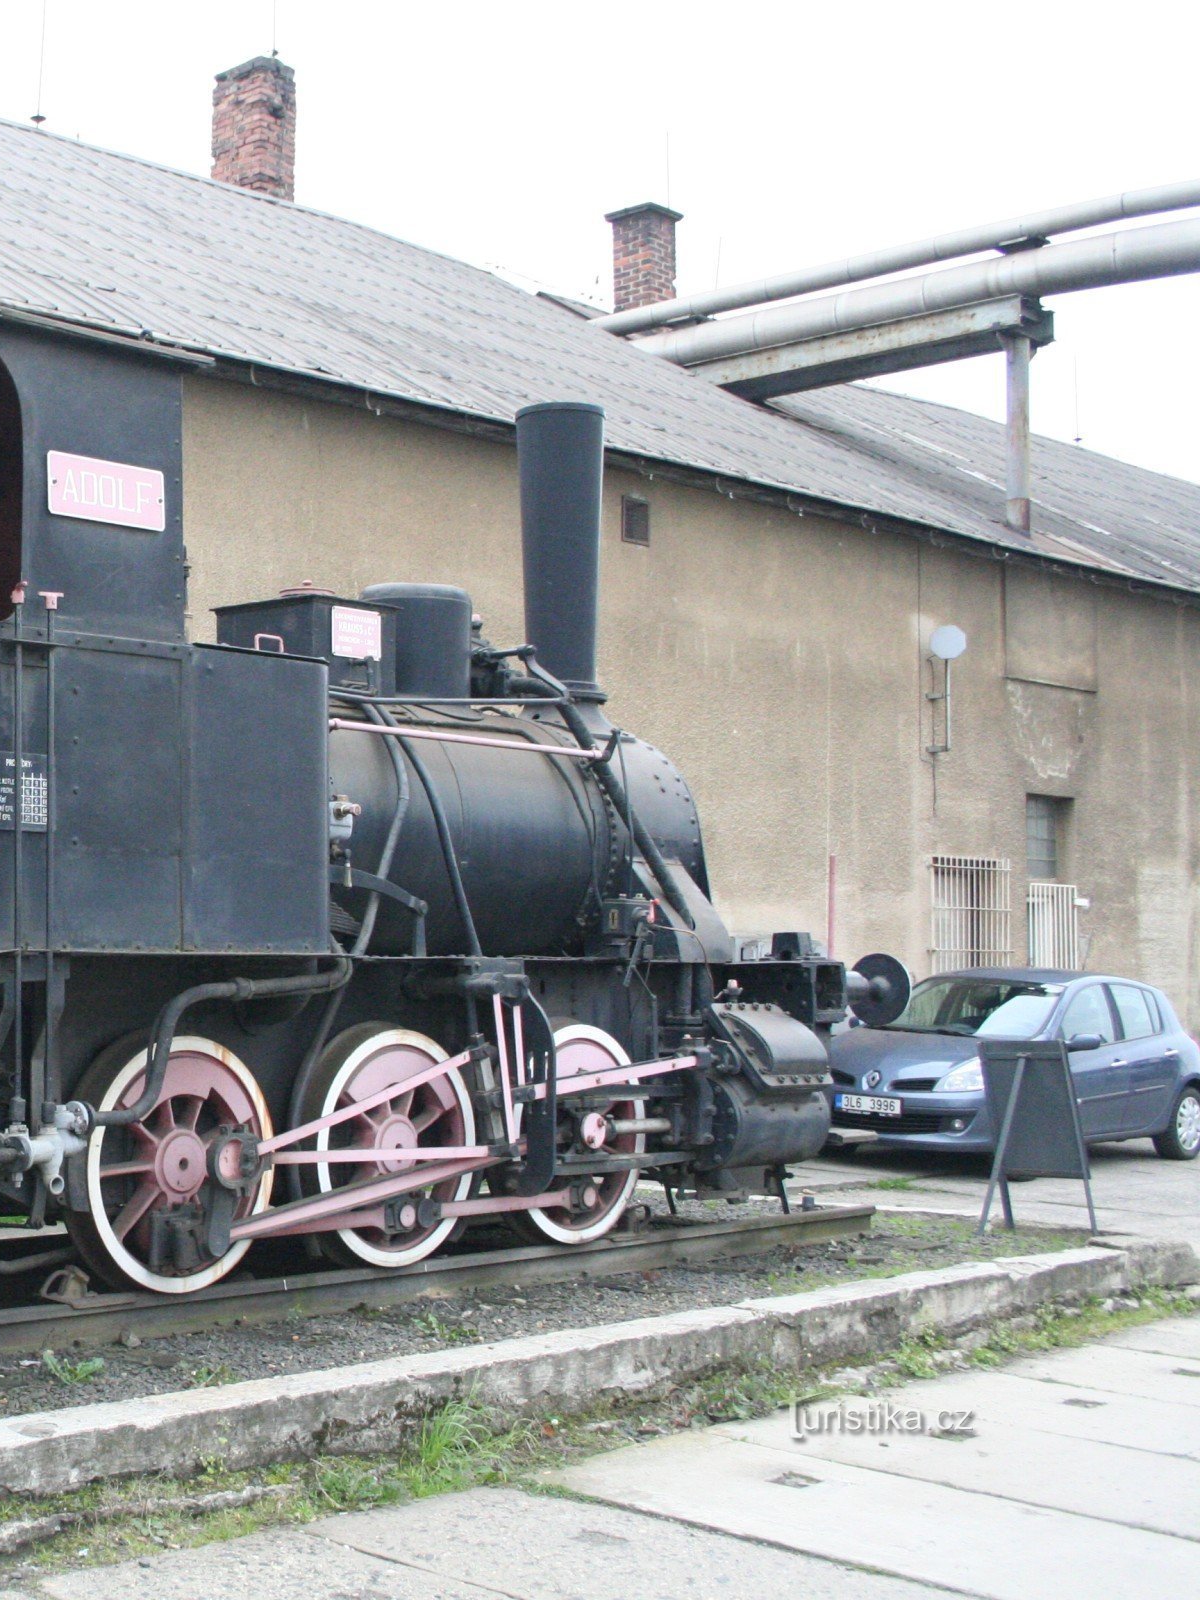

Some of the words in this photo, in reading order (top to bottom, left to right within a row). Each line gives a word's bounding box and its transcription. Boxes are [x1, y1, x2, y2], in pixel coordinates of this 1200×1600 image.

[62, 469, 152, 513] ADOLF
[338, 621, 363, 634] KRAUSS
[844, 1096, 862, 1108] 3L6
[870, 1099, 896, 1112] 3996
